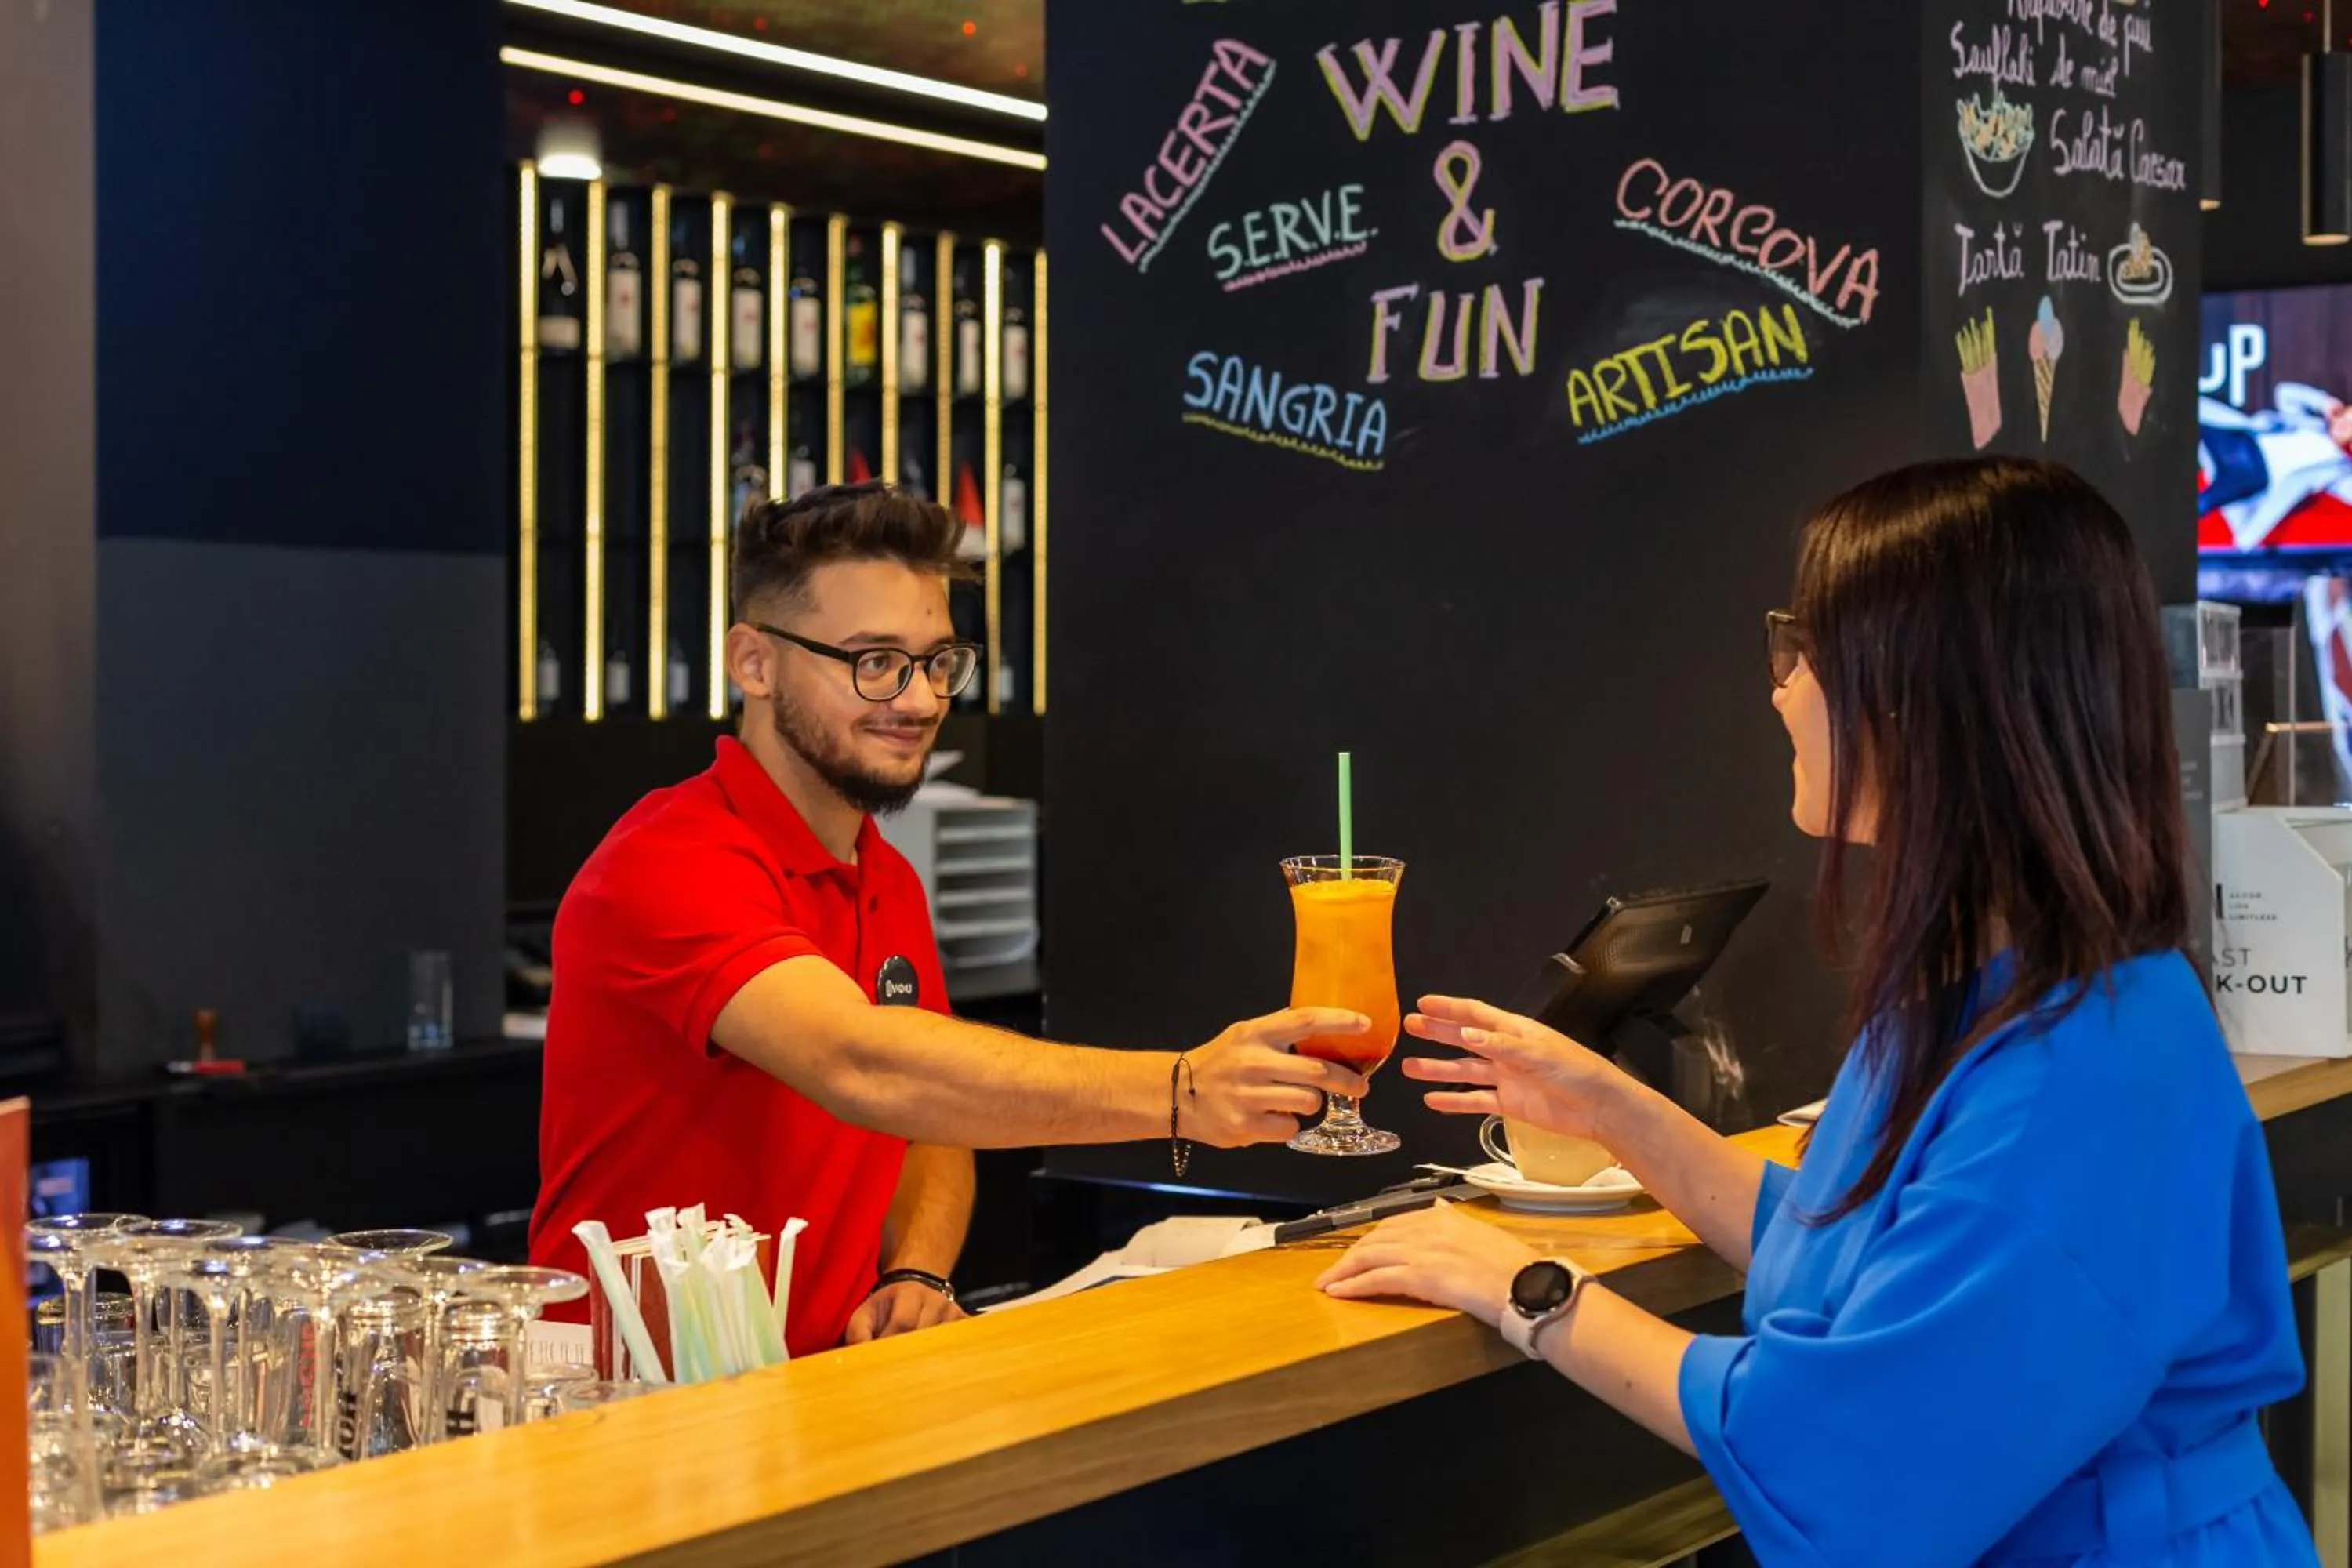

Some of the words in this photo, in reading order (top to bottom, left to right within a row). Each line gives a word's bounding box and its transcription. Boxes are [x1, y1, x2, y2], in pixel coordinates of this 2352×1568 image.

[1316, 0, 1620, 141] WINE
[2049, 33, 2074, 89] de
[1101, 38, 1270, 265] LACERTA
[1433, 140, 1498, 262] &
[1616, 158, 1880, 325] CORCOVA
[1367, 278, 1545, 384] FUN
[1567, 303, 1808, 427] ARTISAN
[1183, 352, 1387, 456] SANGRIA
